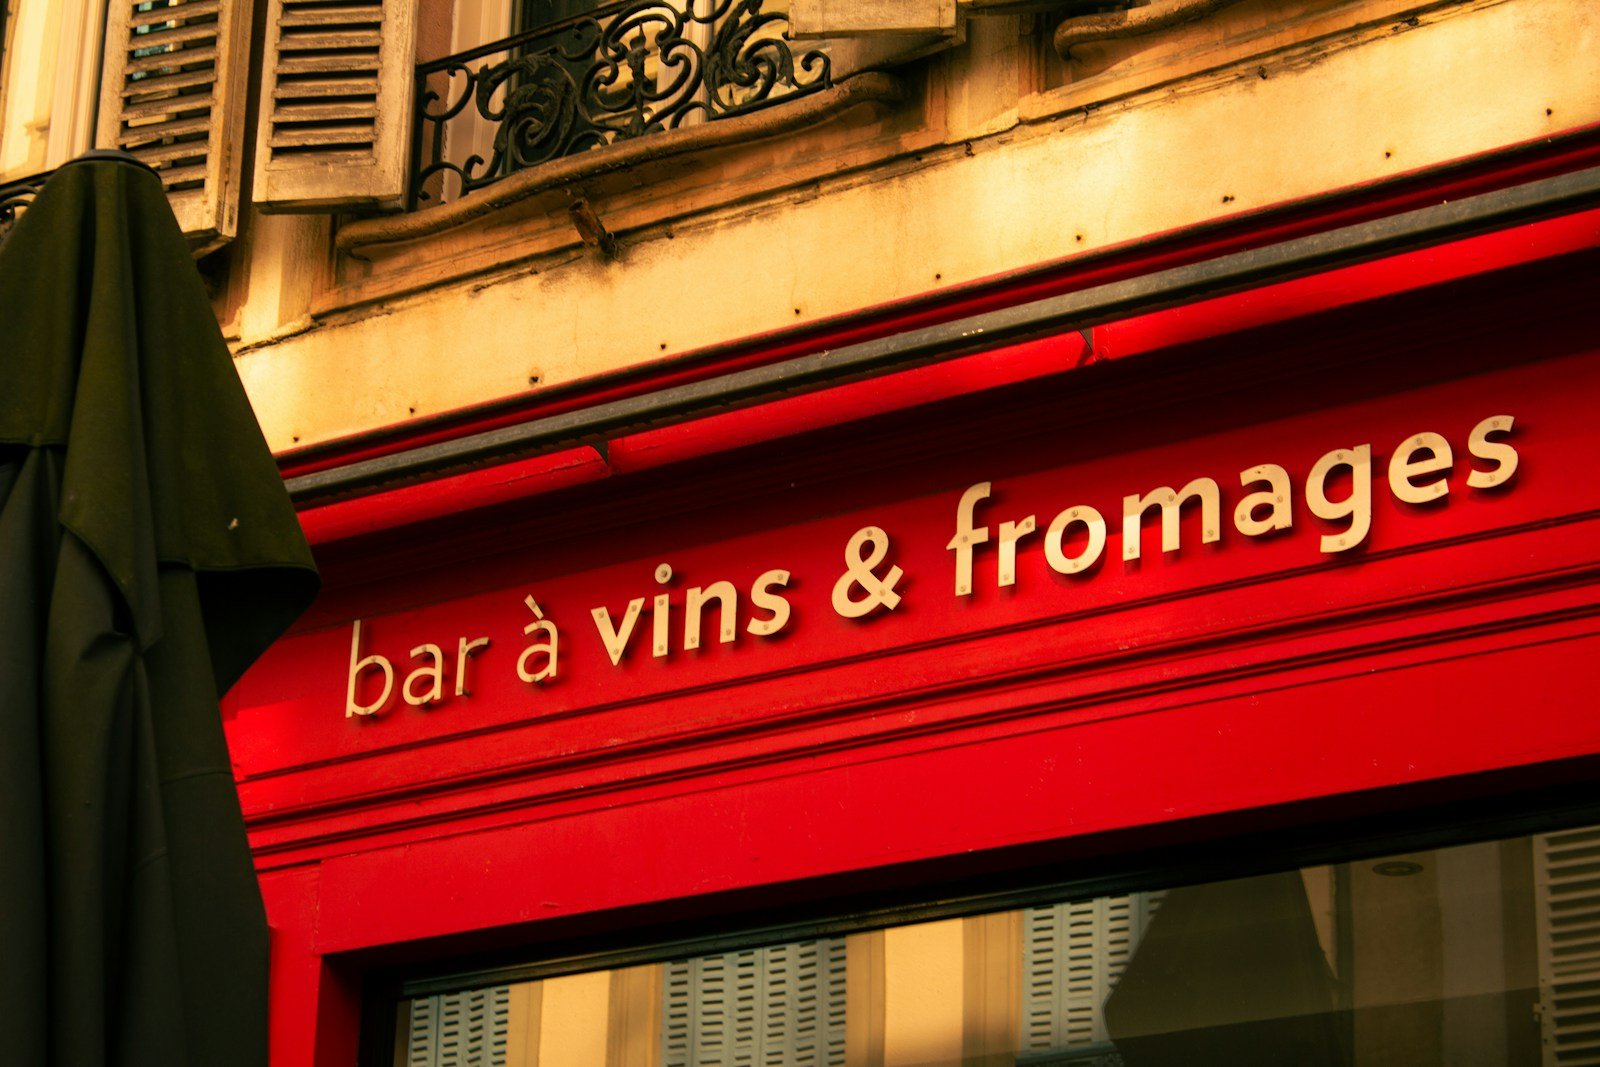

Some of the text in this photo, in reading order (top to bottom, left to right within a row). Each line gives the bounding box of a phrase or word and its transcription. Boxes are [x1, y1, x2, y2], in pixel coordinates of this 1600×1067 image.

[345, 415, 1520, 719] bar à vins & fromages
